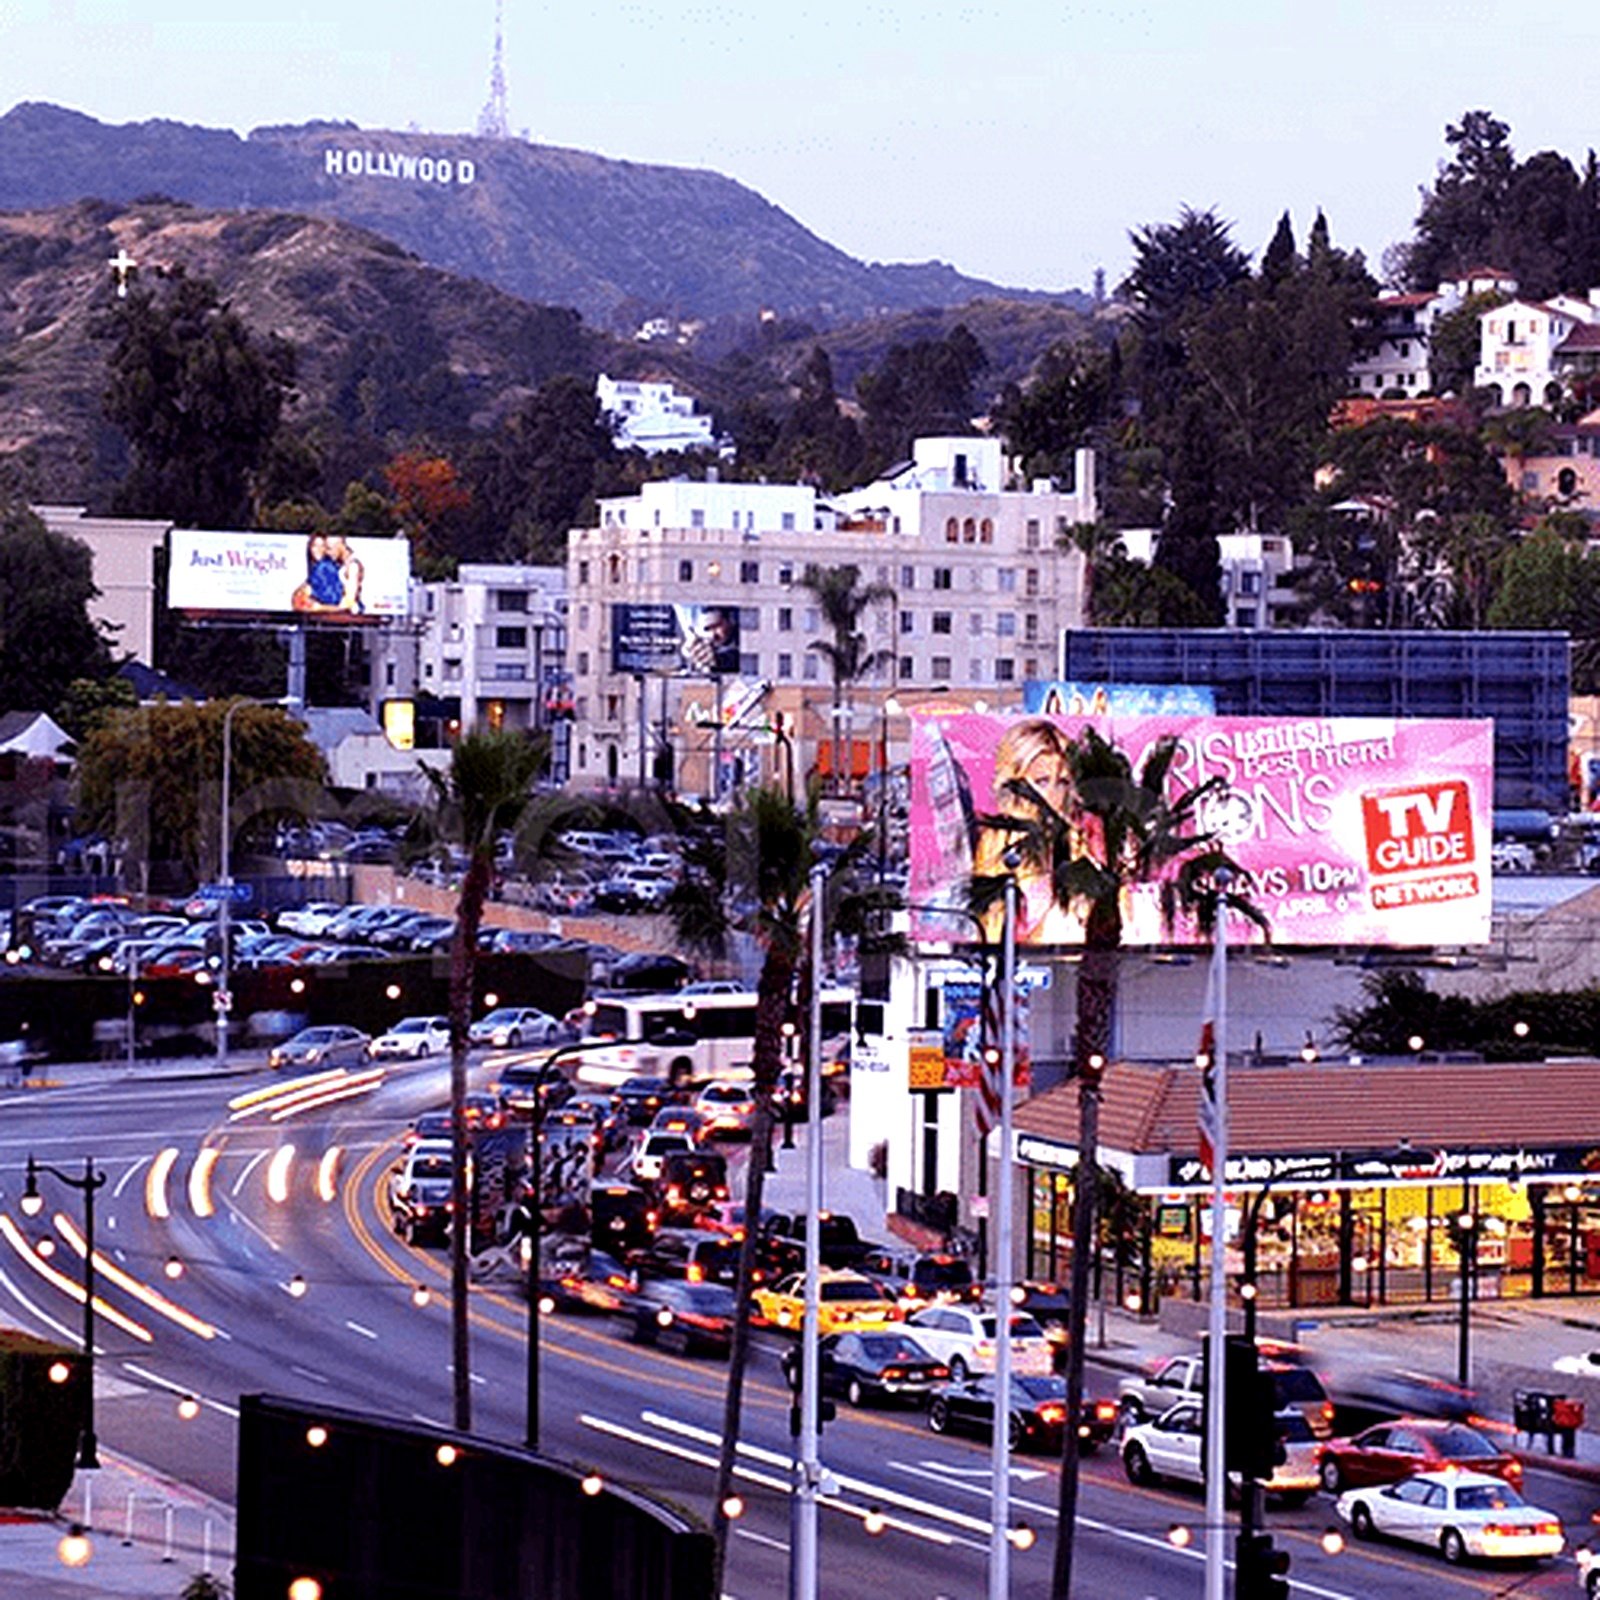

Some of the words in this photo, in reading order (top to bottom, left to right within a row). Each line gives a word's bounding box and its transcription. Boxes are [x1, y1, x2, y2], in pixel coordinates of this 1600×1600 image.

[325, 149, 475, 184] HOLLYWOOD
[190, 549, 223, 567] Just
[226, 549, 288, 575] Wright
[1305, 737, 1397, 770] Friend
[1377, 789, 1456, 838] TV
[1376, 832, 1467, 869] GUIDE
[1374, 877, 1477, 905] NETWORK
